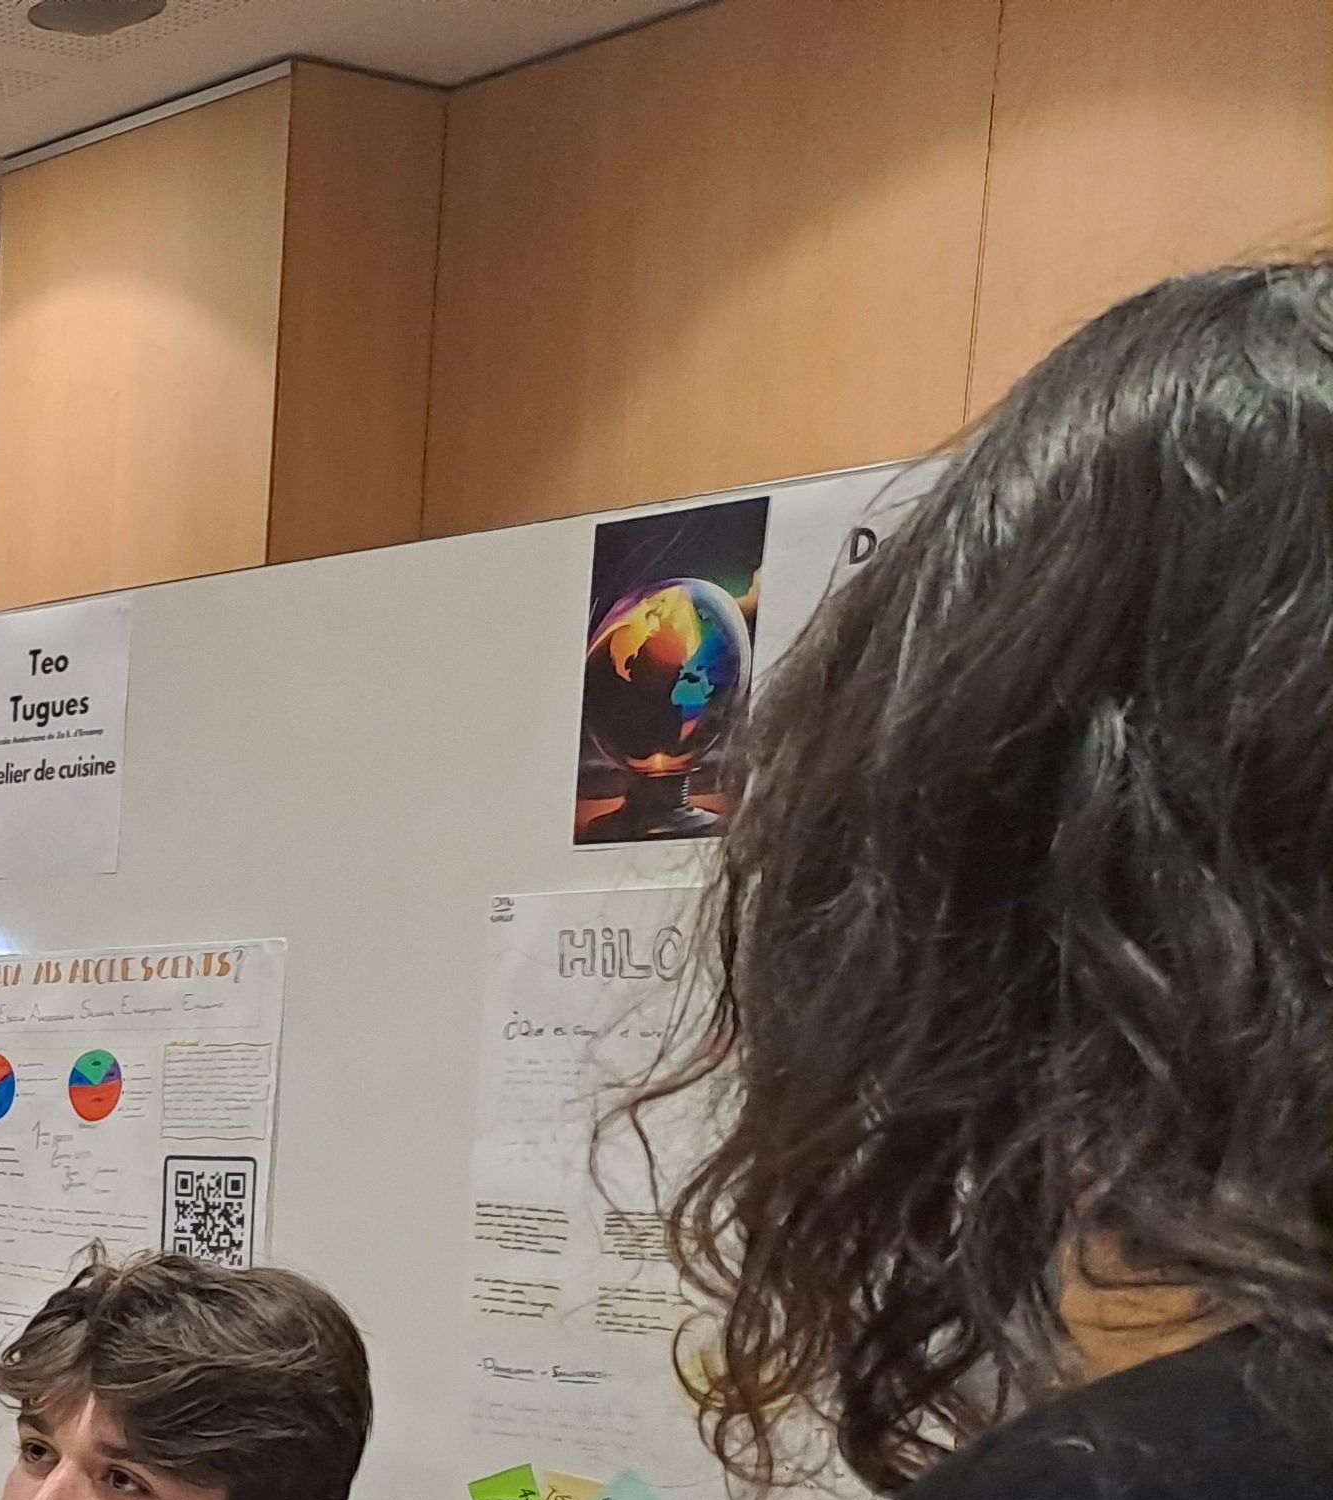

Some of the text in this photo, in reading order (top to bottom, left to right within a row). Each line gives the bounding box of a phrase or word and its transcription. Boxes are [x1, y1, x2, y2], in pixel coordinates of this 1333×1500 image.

[29, 649, 69, 676] Teo
[10, 695, 89, 727] Tugues
[34, 758, 55, 781] de
[58, 755, 117, 780] cuisine
